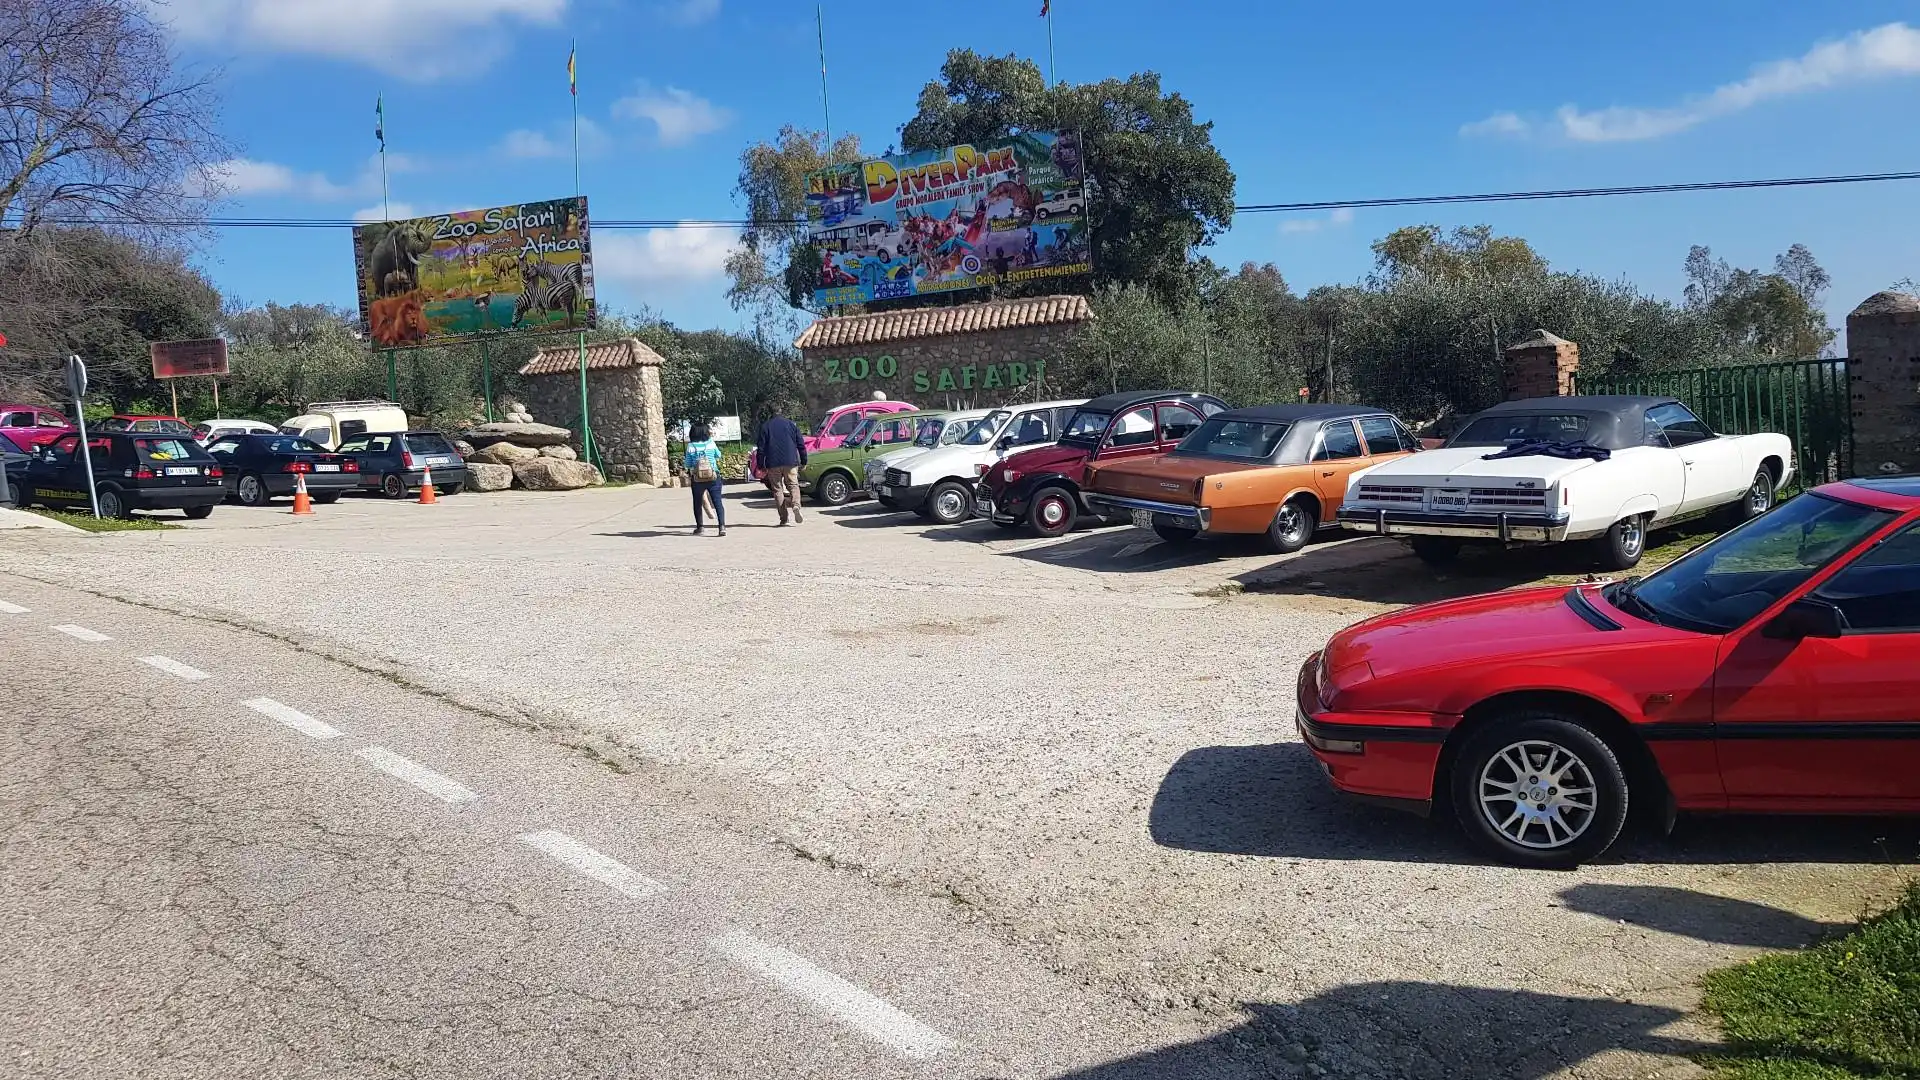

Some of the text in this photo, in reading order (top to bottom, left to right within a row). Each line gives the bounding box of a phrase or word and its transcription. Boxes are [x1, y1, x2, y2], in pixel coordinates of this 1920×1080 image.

[1028, 166, 1051, 175] Parque
[896, 198, 913, 208] GRUPO
[946, 187, 966, 199] FAMILY
[968, 182, 985, 194] SHOW
[432, 204, 555, 240] Zoo Safari
[1007, 263, 1088, 282] ENTRETENIMIENTO
[823, 354, 1046, 393] ZOO SAFARI
